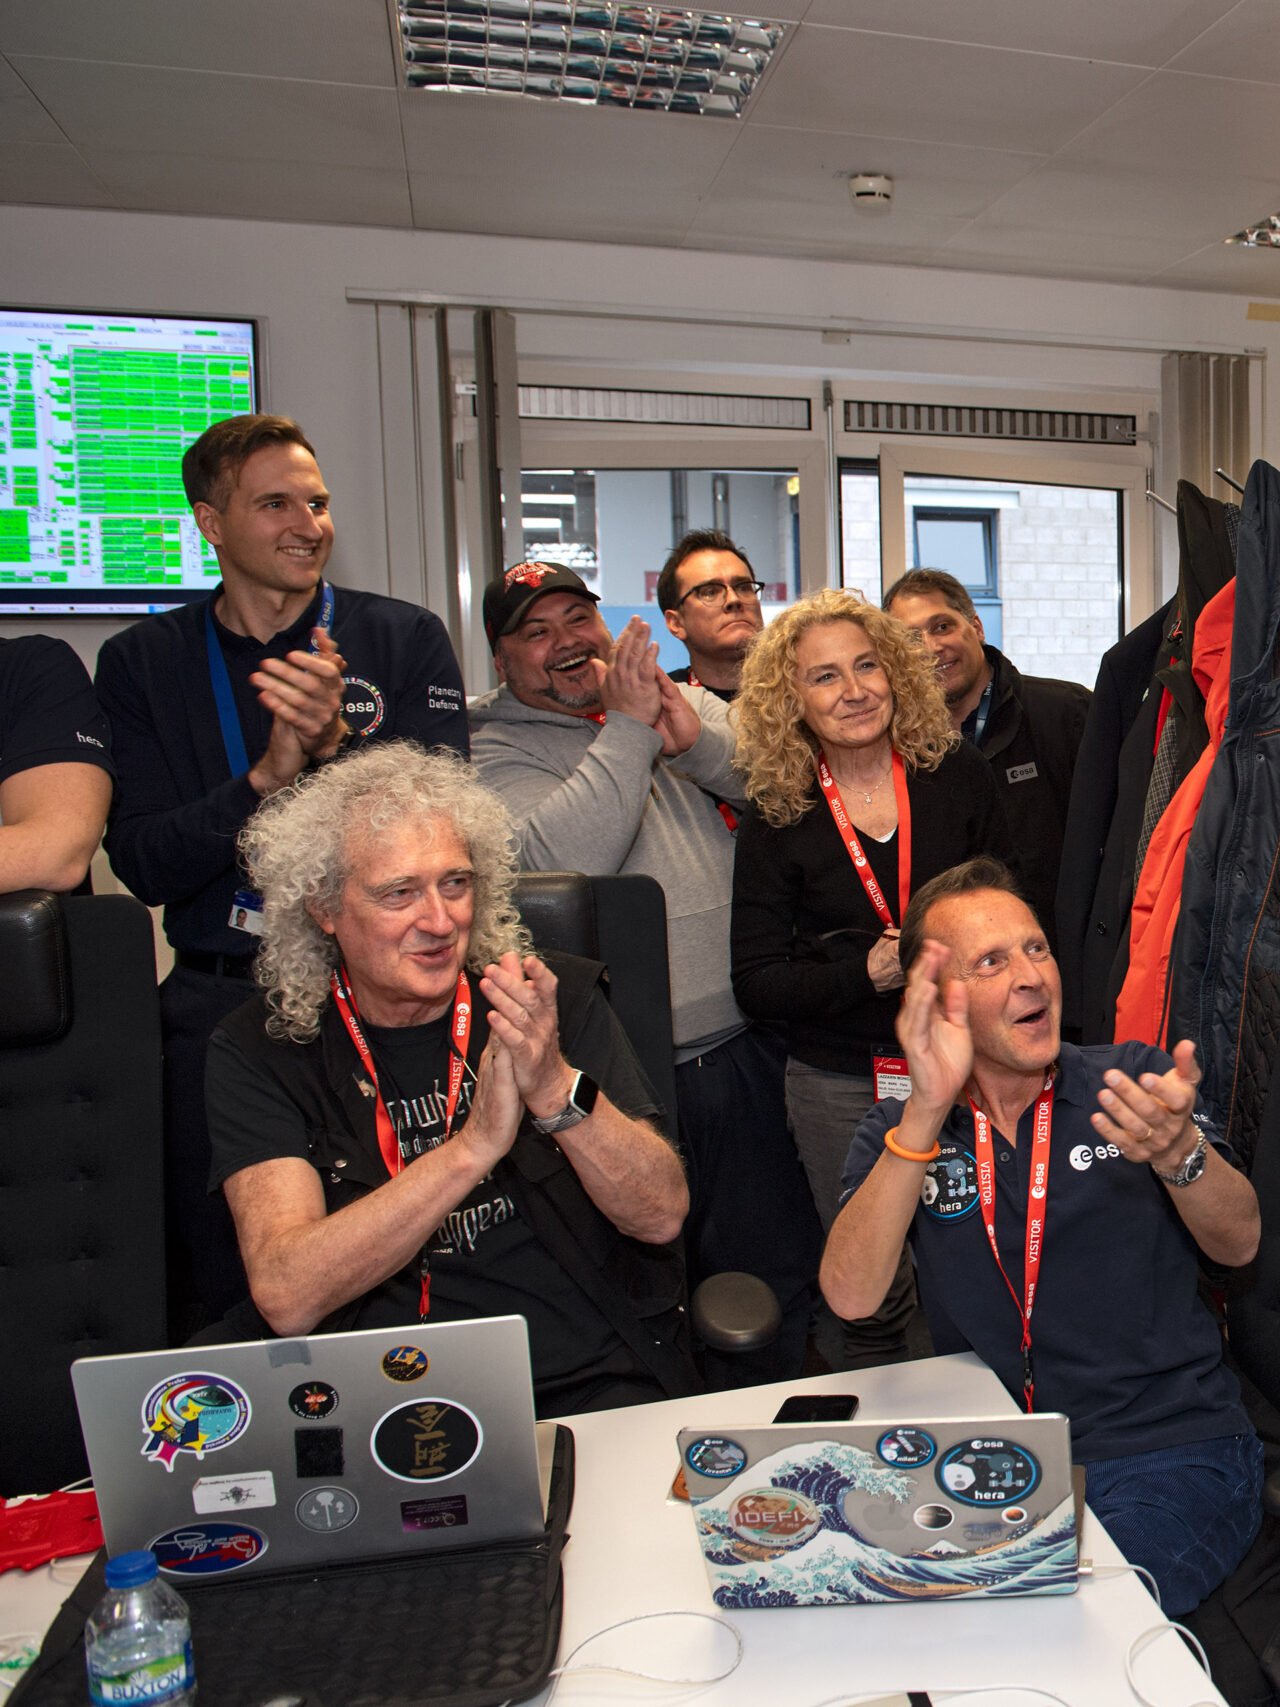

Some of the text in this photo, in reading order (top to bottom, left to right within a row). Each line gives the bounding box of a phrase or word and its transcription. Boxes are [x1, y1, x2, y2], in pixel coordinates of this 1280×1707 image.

[428, 685, 462, 700] Planetary
[345, 701, 375, 713] esa
[428, 698, 460, 711] Defence
[76, 731, 105, 748] hera
[1019, 767, 1034, 776] esa
[831, 797, 849, 829] VISITOR
[850, 840, 861, 857] esa
[866, 878, 885, 911] VISITOR
[456, 1015, 467, 1036] esa
[1037, 1101, 1050, 1144] VISITOR
[979, 1123, 987, 1143] esa
[1094, 1143, 1124, 1160] es
[1035, 1163, 1045, 1184] esa
[980, 1161, 993, 1206] VISITOR
[939, 1202, 962, 1213] hera
[1029, 1218, 1042, 1264] VISITOR
[974, 1490, 1005, 1500] hera
[738, 1509, 815, 1523] IDEFIX
[112, 1670, 181, 1700] BUXTON
